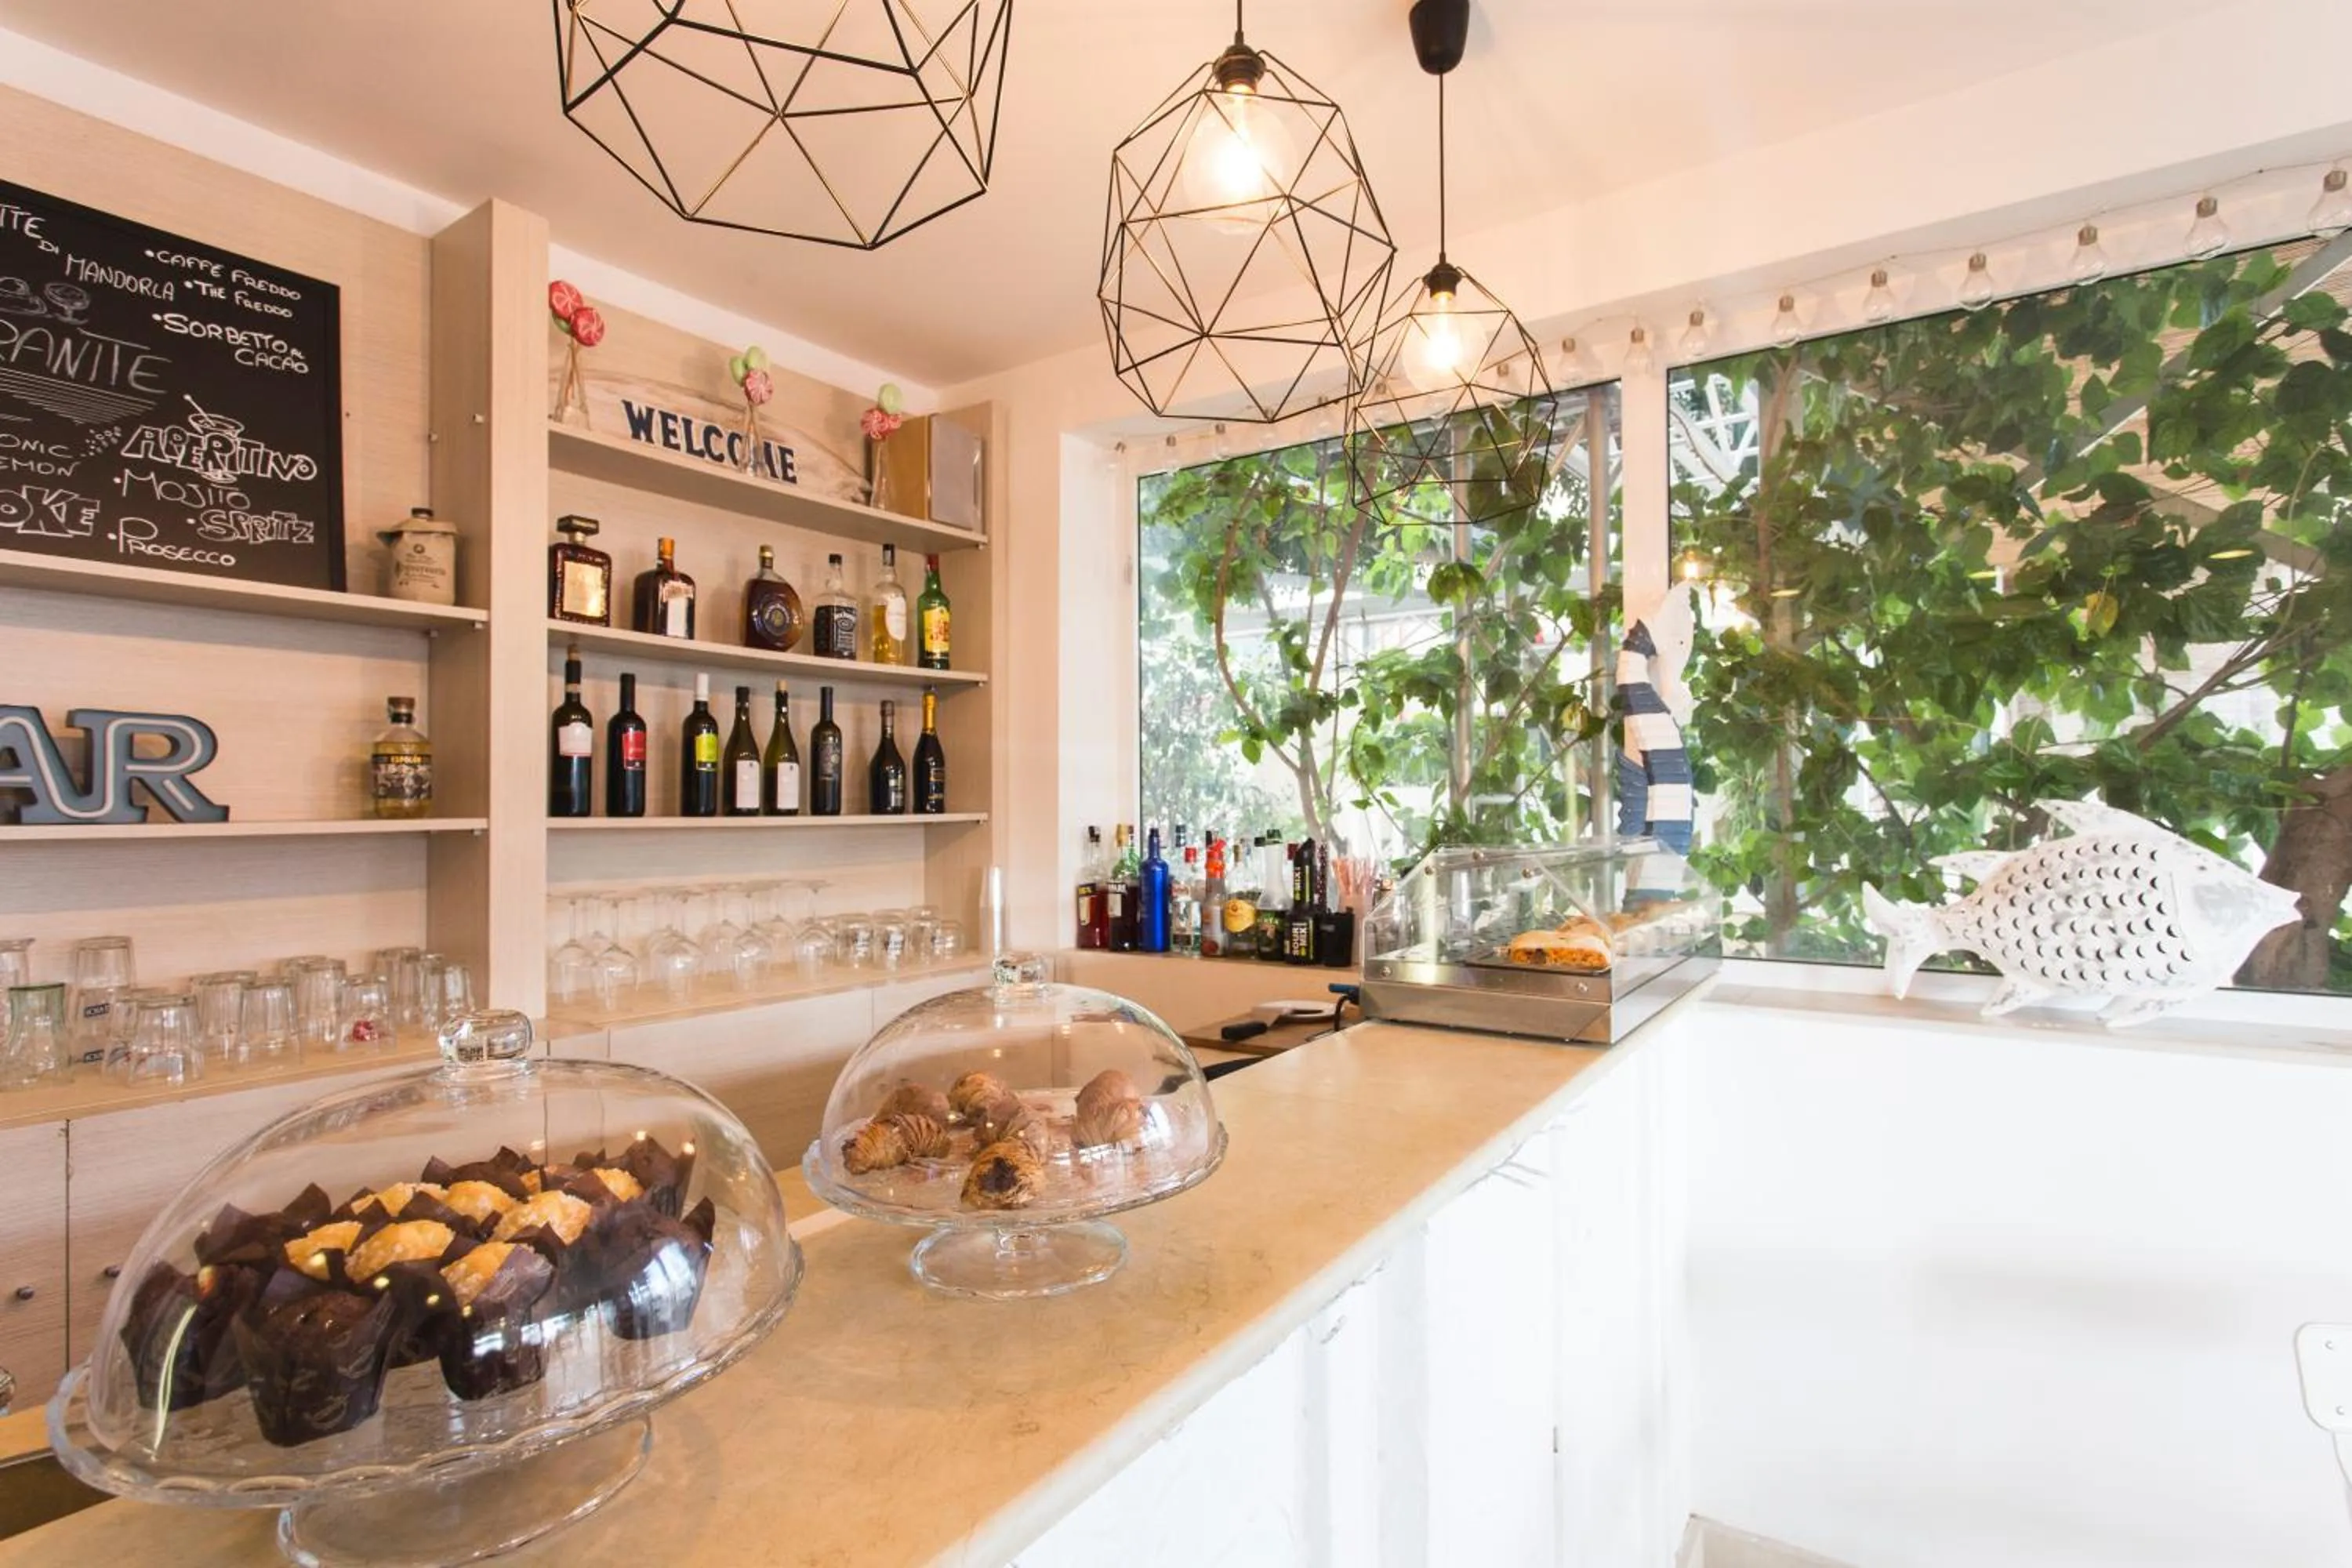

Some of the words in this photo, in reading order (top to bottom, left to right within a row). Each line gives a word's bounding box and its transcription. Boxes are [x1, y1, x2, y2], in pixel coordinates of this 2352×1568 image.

[65, 253, 174, 302] MANDORLA
[157, 250, 223, 278] CAFFE
[231, 270, 302, 300] FREDDO
[194, 280, 227, 299] THE
[234, 291, 292, 318] FREDDO
[163, 314, 289, 354] SORBETTO
[234, 348, 309, 374] CACAO
[0, 434, 73, 459] ONIC
[121, 424, 318, 482] APERITIVO
[122, 468, 251, 510] MOJITO
[119, 517, 237, 567] PROSECCO
[197, 509, 314, 545] SPRITZ
